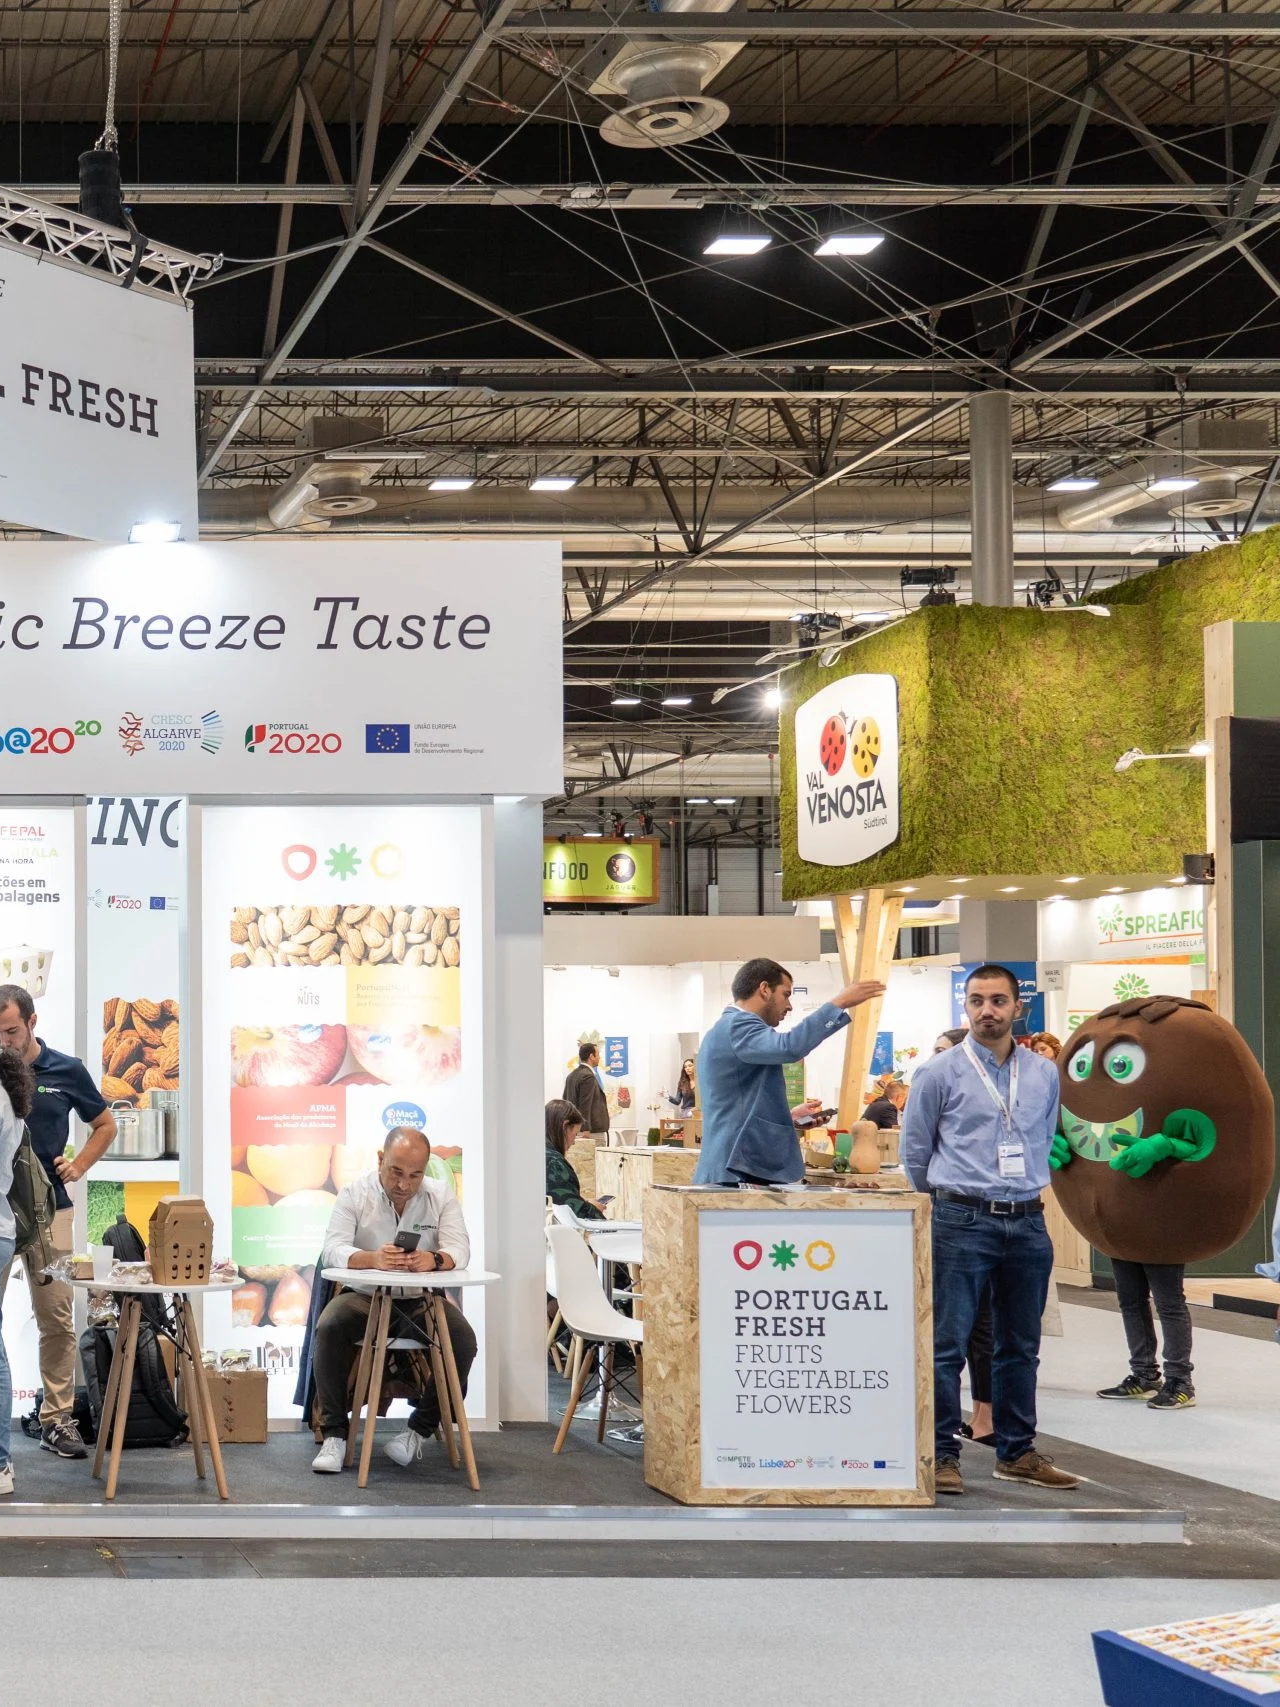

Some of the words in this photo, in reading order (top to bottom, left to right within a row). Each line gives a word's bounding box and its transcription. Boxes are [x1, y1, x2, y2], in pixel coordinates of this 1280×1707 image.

[22, 362, 160, 438] FRESH
[62, 597, 286, 651] Breeze
[313, 597, 491, 651] Taste
[151, 715, 192, 725] CRESC
[269, 723, 309, 731] PORTUGAL
[143, 728, 201, 739] ALGARVE
[268, 732, 342, 754] 2020
[159, 741, 186, 752] 2020
[806, 771, 824, 791] VAL
[807, 777, 887, 826] VENOSTA
[0, 826, 46, 836] FEPAL
[863, 815, 888, 829] Südtirol
[27, 879, 46, 888] em
[116, 900, 142, 909] 2020
[734, 1289, 888, 1311] PORTUGAL
[734, 1316, 826, 1337] FRESH
[735, 1344, 823, 1364] FRUITS
[735, 1370, 889, 1390] VEGETABLES
[735, 1395, 852, 1414] FLOWERS
